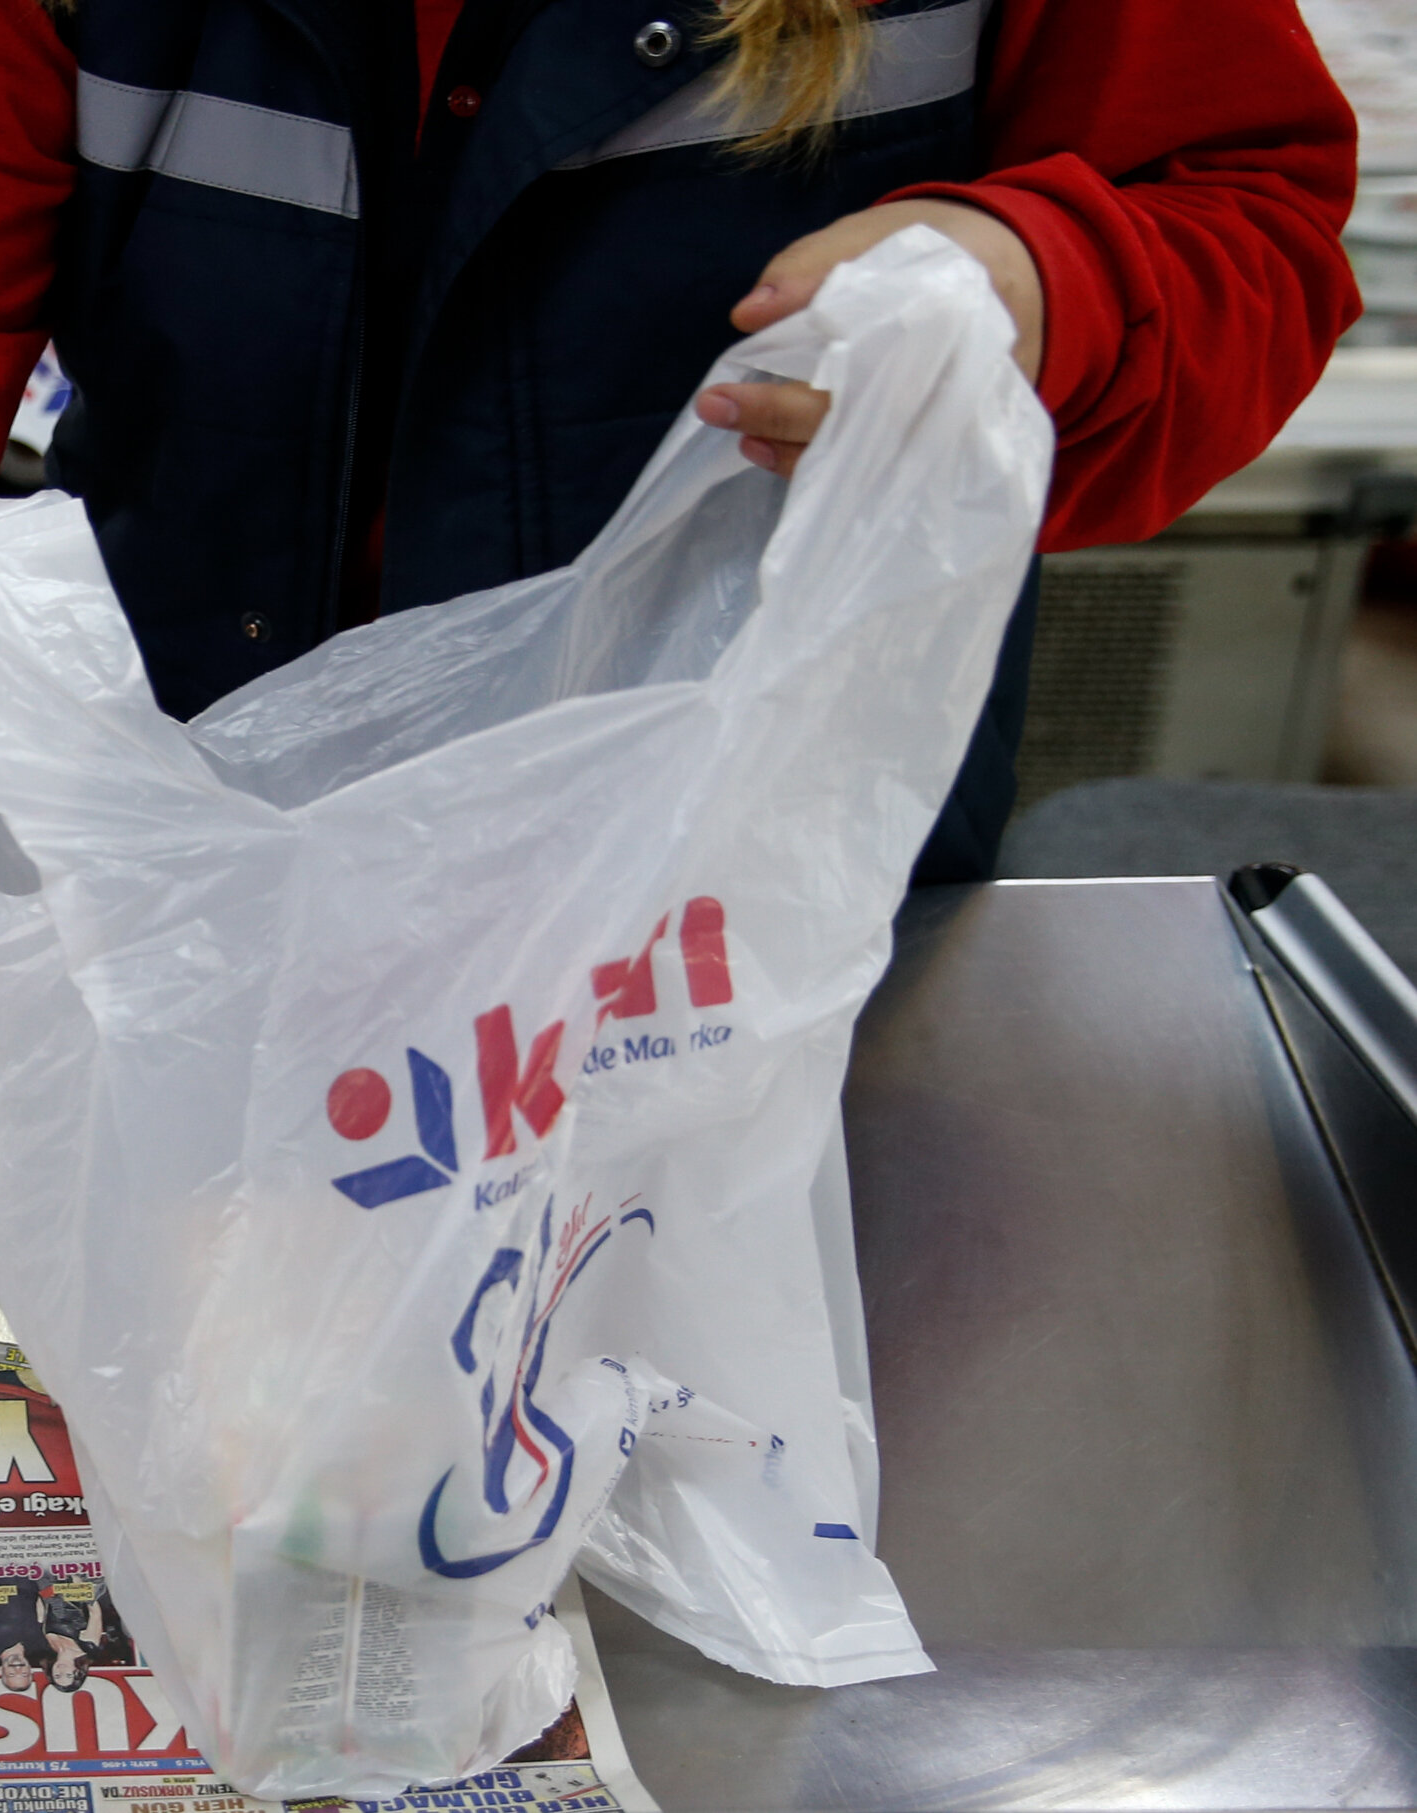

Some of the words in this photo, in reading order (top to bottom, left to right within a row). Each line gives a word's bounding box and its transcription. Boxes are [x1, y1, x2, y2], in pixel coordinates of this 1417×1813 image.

[50, 1761, 70, 1771] 75
[59, 1785, 86, 1799] NE
[193, 1798, 245, 1812] HER
[536, 1794, 608, 1812] HER
